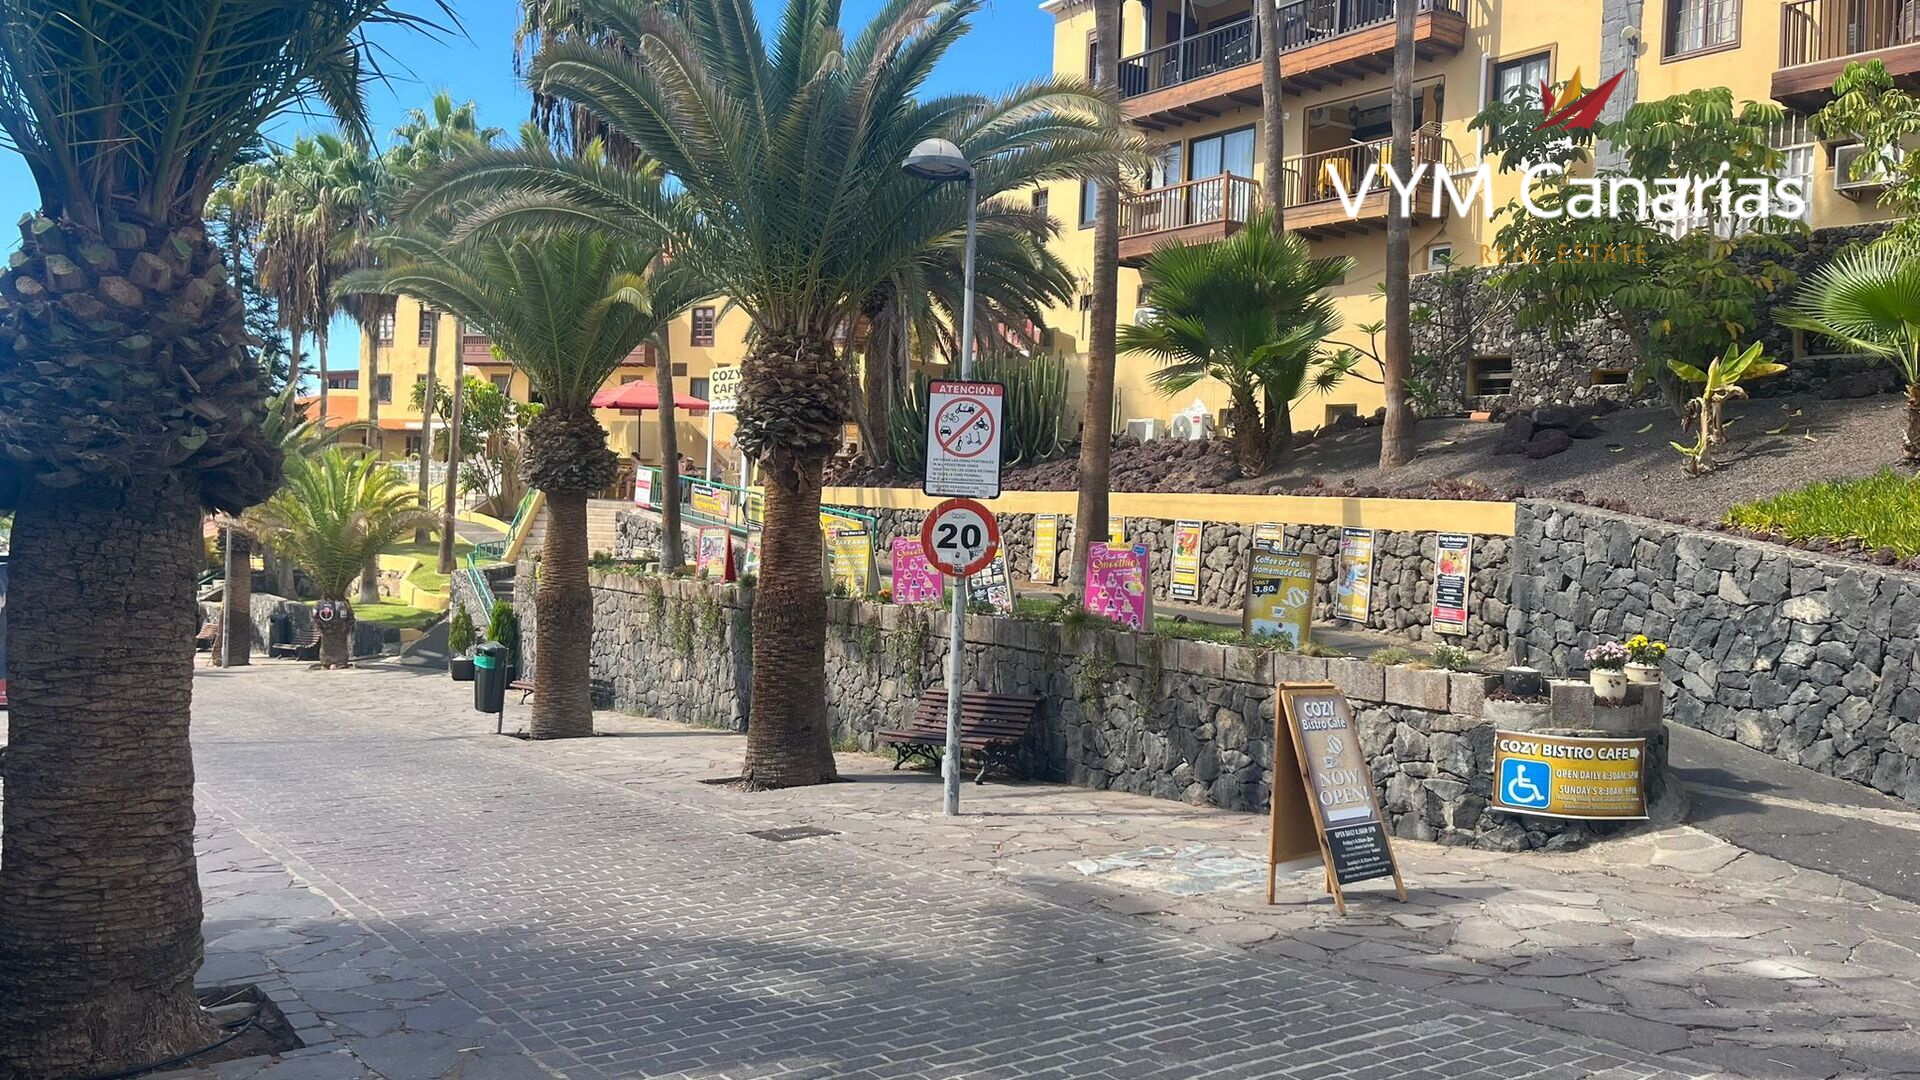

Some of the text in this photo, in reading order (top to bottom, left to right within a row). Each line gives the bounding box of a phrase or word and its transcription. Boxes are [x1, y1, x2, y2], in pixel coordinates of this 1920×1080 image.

[712, 369, 742, 382] COZY
[938, 384, 995, 396] ATENCIÓN
[937, 523, 982, 549] 20
[1255, 555, 1278, 565] Coffee
[1252, 564, 1293, 577] Homemade
[1294, 569, 1312, 579] Cake
[1303, 700, 1335, 718] COZY
[1302, 717, 1346, 730] Bistro Cafe
[1499, 739, 1629, 760] COZY BISTRO CAFE
[1319, 768, 1361, 788] NOW
[1556, 769, 1578, 779] OPEN
[1580, 770, 1600, 780] DAILY
[1320, 784, 1371, 807] OPEN!
